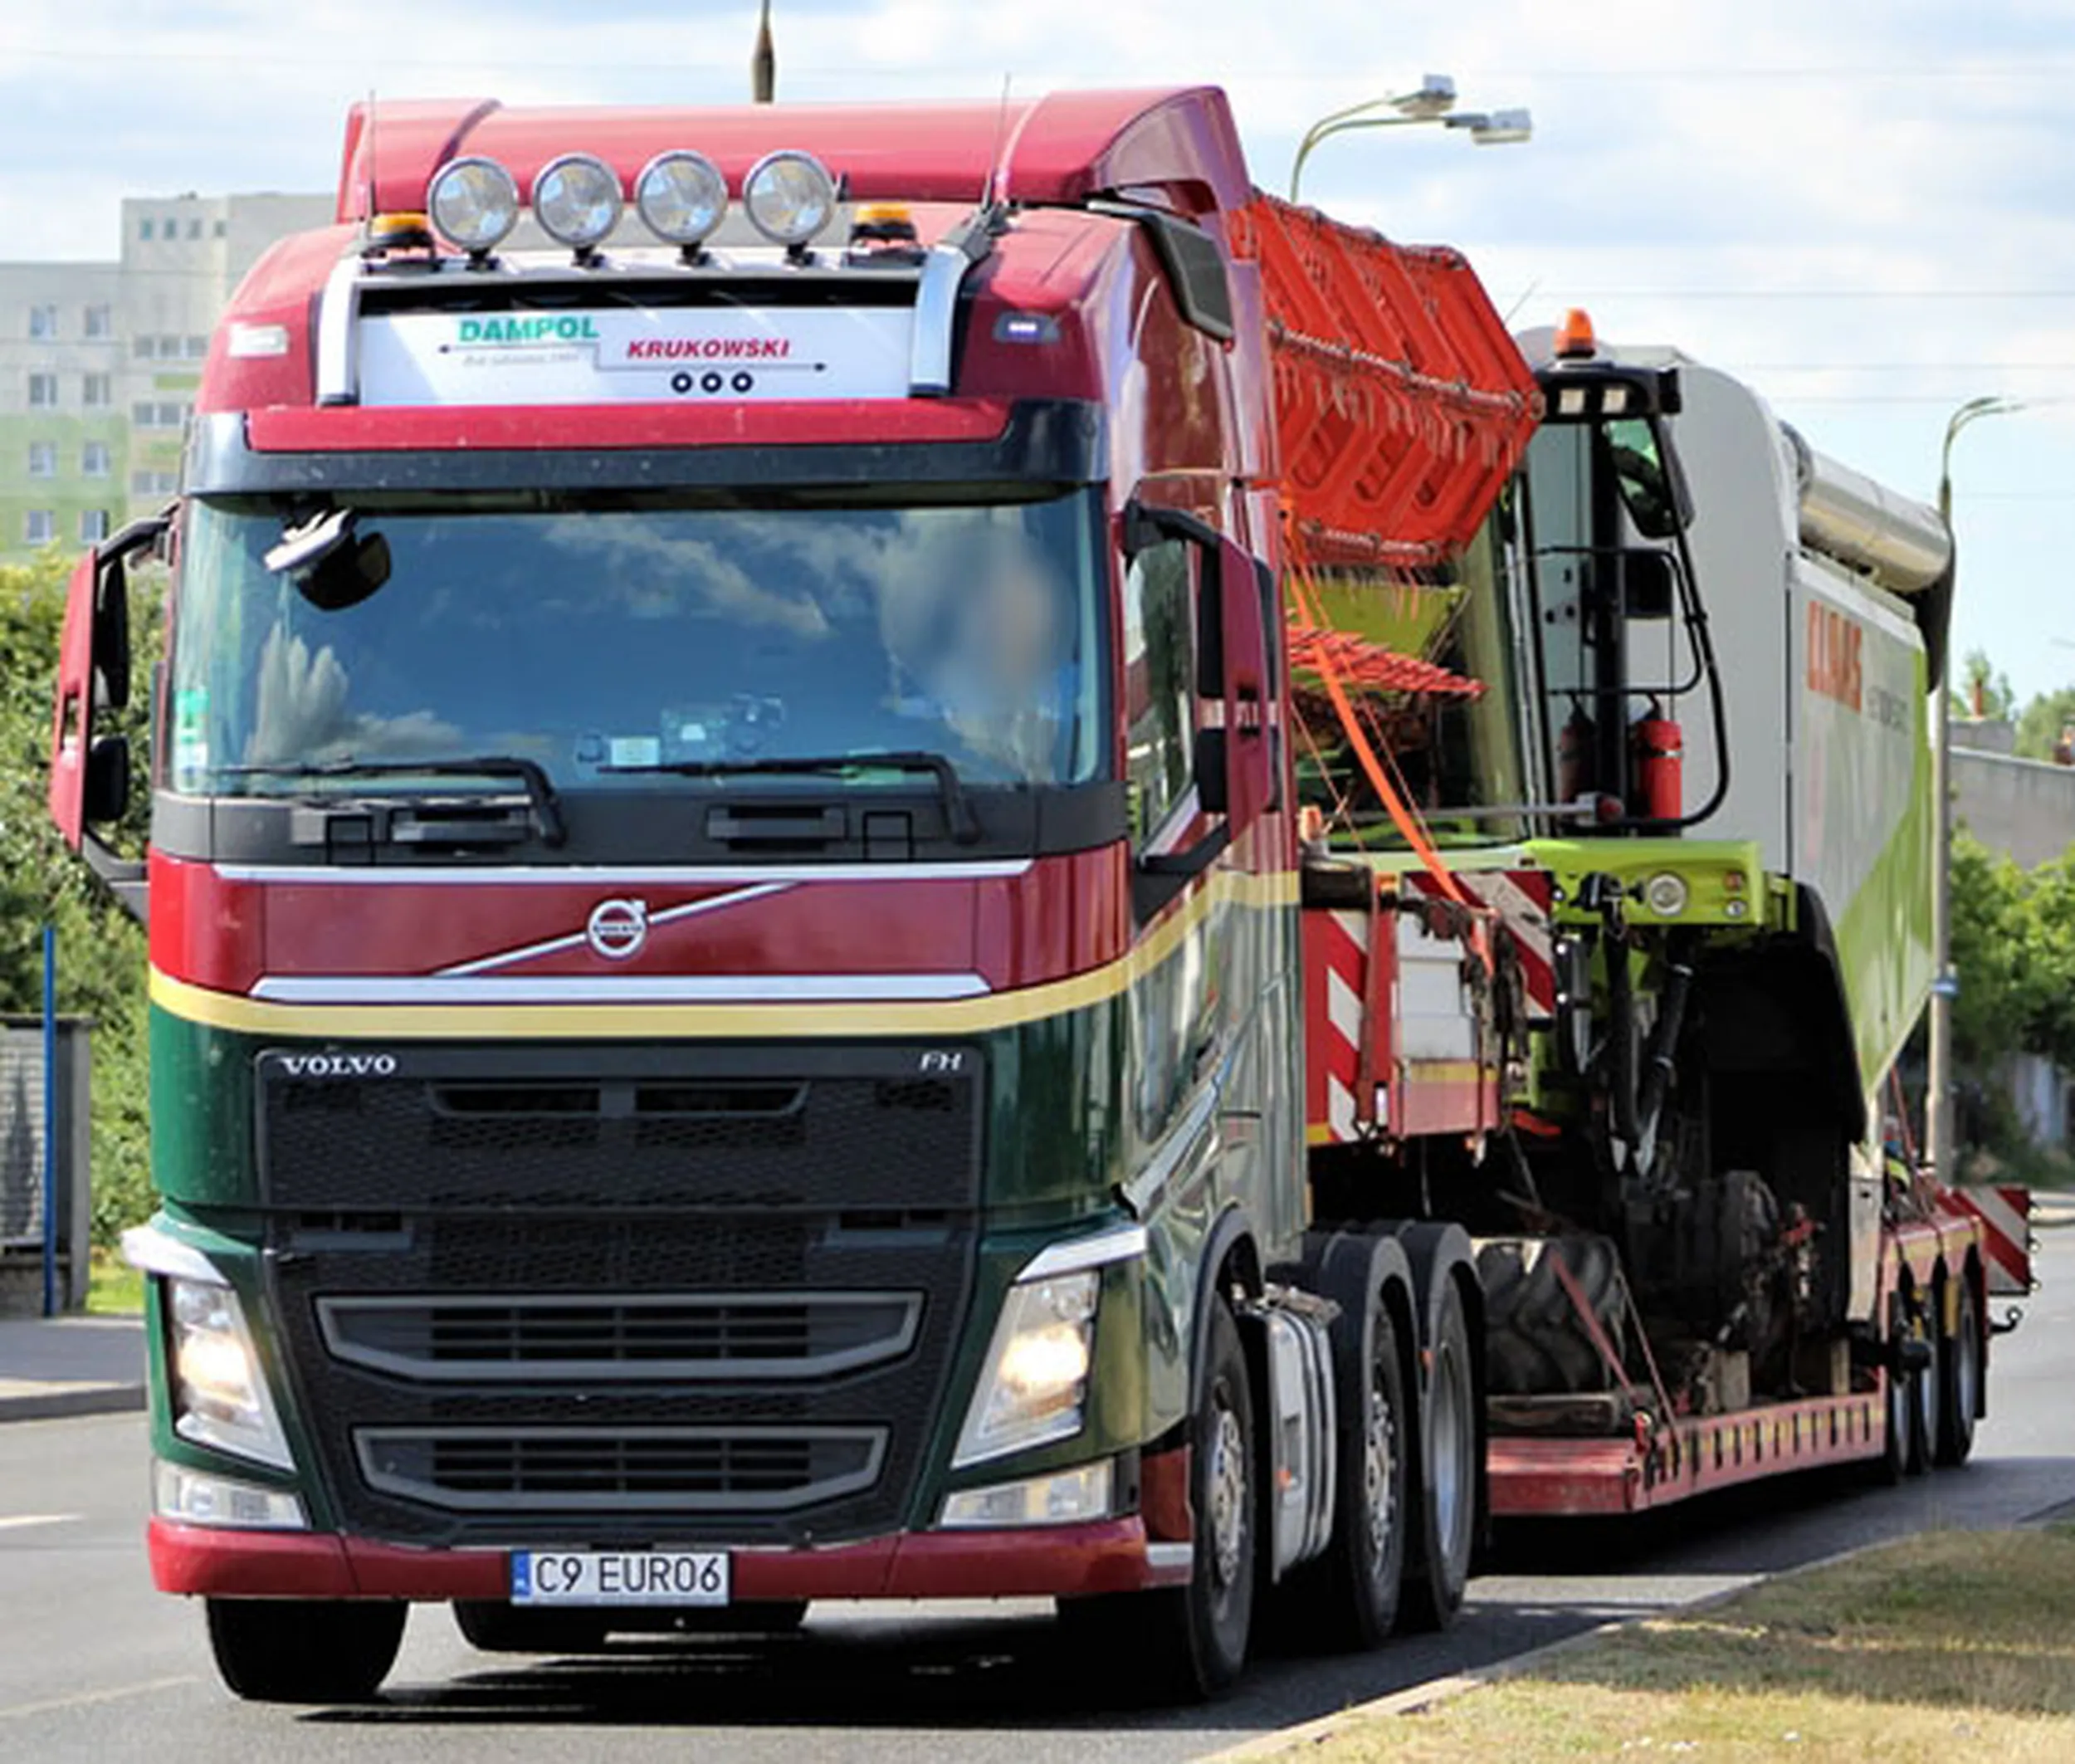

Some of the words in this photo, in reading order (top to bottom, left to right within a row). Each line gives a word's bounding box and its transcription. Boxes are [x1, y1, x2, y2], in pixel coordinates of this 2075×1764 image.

[459, 316, 600, 342] DAMPOL
[627, 339, 790, 358] KRUKOWSKI
[281, 1053, 396, 1075] VOLVO
[920, 1052, 962, 1071] FH
[536, 1556, 583, 1592] C9
